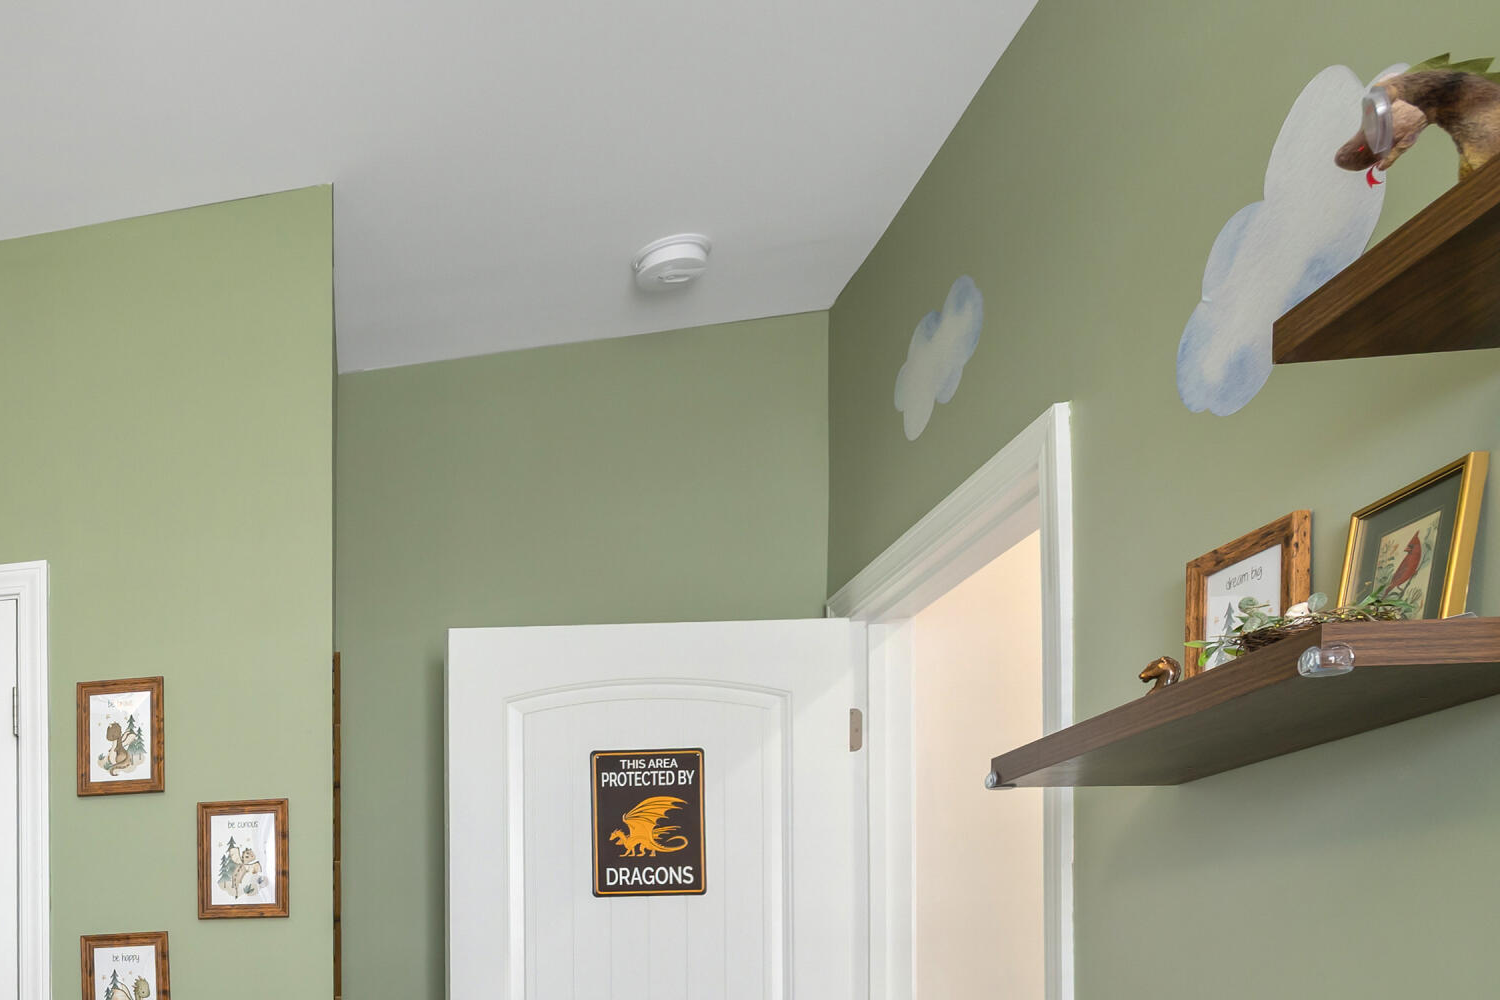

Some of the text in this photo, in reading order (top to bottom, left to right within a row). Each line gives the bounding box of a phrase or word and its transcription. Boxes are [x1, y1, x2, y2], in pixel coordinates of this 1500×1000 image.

[1226, 566, 1262, 590] dream big
[620, 758, 678, 769] THIS AREA
[601, 770, 695, 787] PROTECTED BY
[227, 820, 259, 828] be curious
[606, 866, 694, 885] DRAGONS
[112, 953, 140, 963] be happy
